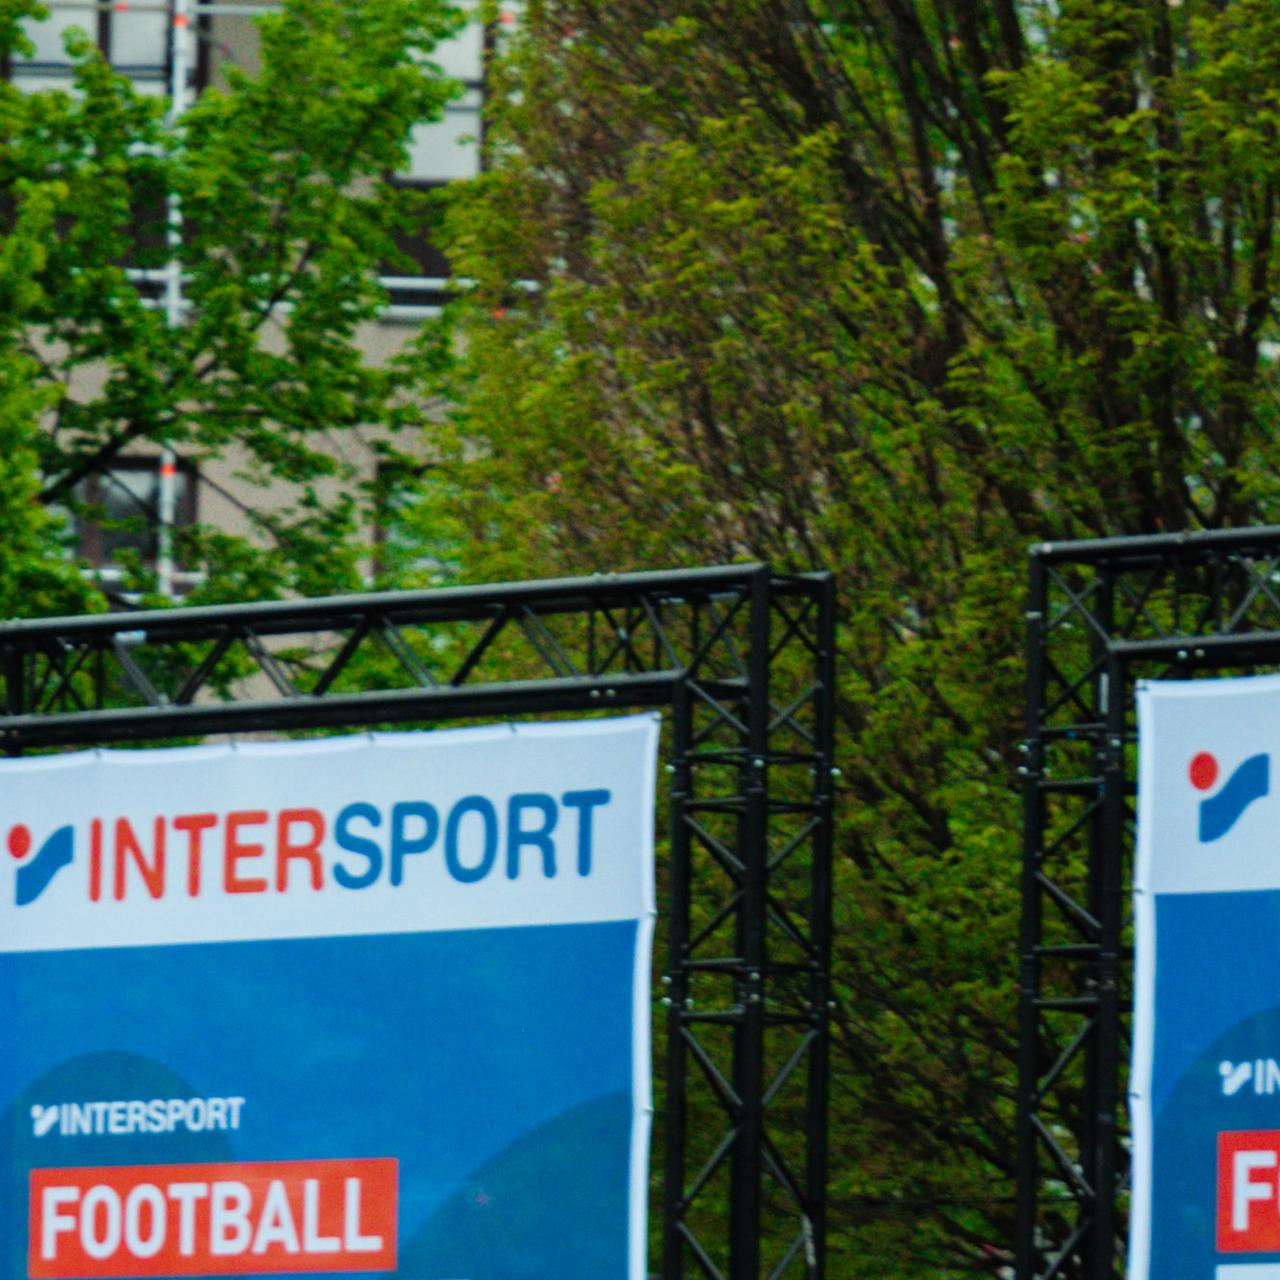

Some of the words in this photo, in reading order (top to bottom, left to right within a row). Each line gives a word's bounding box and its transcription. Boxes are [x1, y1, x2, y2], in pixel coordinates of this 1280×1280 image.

[89, 788, 612, 902] INTERSPORT
[60, 1097, 245, 1135] INTERSPORT
[41, 1177, 383, 1260] FOOTBALL
